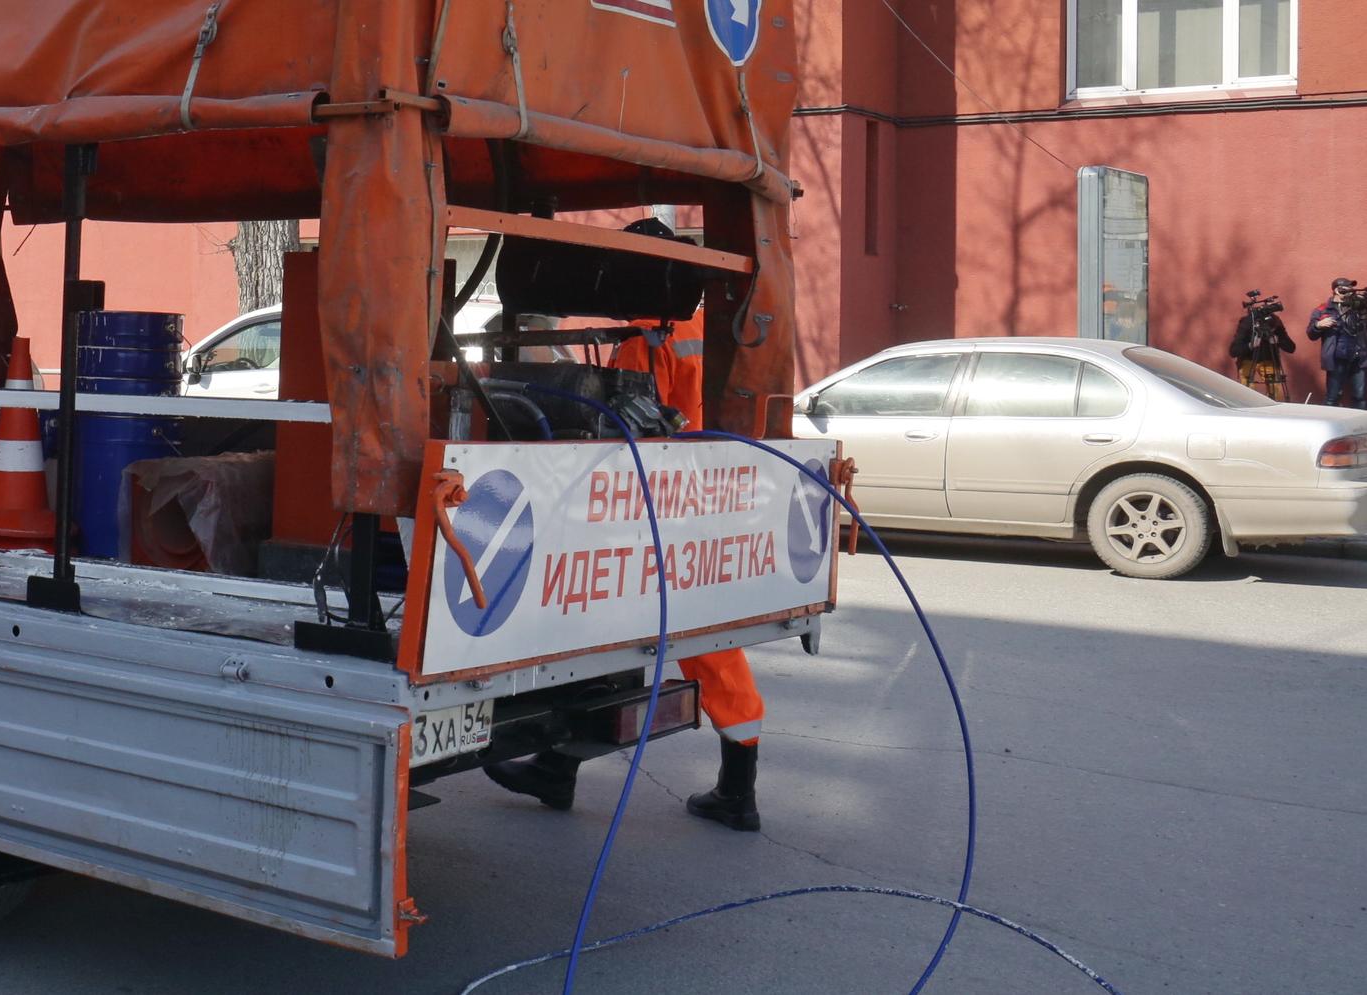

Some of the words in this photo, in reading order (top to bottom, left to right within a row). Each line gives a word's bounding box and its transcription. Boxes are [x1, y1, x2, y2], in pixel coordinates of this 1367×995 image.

[587, 466, 757, 522] ВНИМАНИЕ!
[541, 548, 633, 615] ИДЕТ
[640, 531, 776, 595] РАЗМЕТКА
[410, 714, 456, 757] 3ХА
[464, 700, 485, 733] 54
[460, 733, 477, 746] RUS
